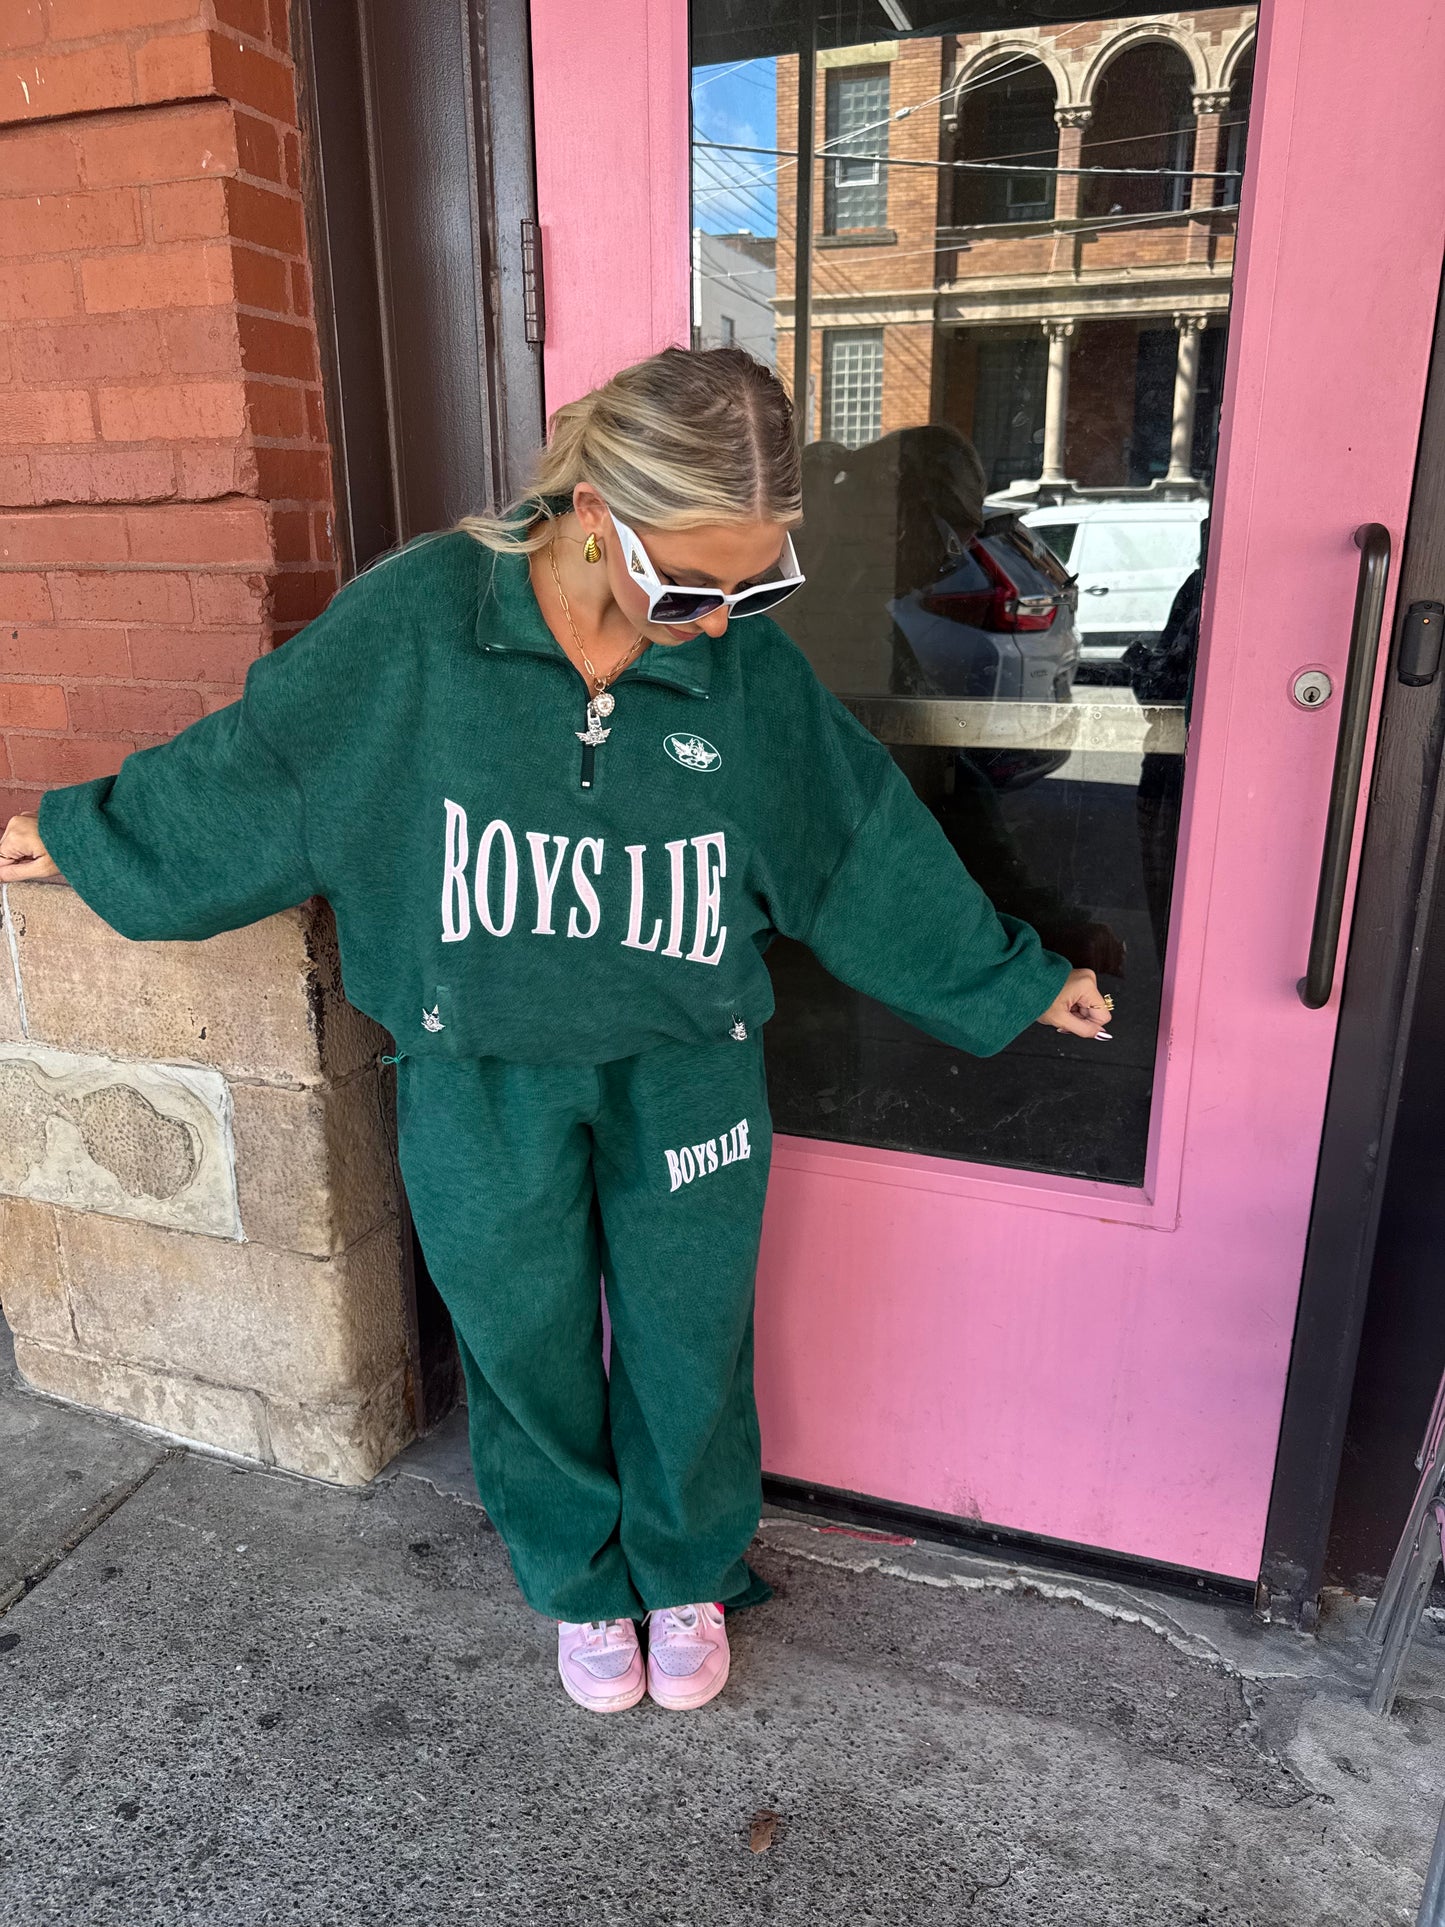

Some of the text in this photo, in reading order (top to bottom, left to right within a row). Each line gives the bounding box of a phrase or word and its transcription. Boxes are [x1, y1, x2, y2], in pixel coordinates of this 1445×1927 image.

[441, 797, 728, 966] BOYS LIE
[664, 1118, 751, 1193] BOYS LIE
